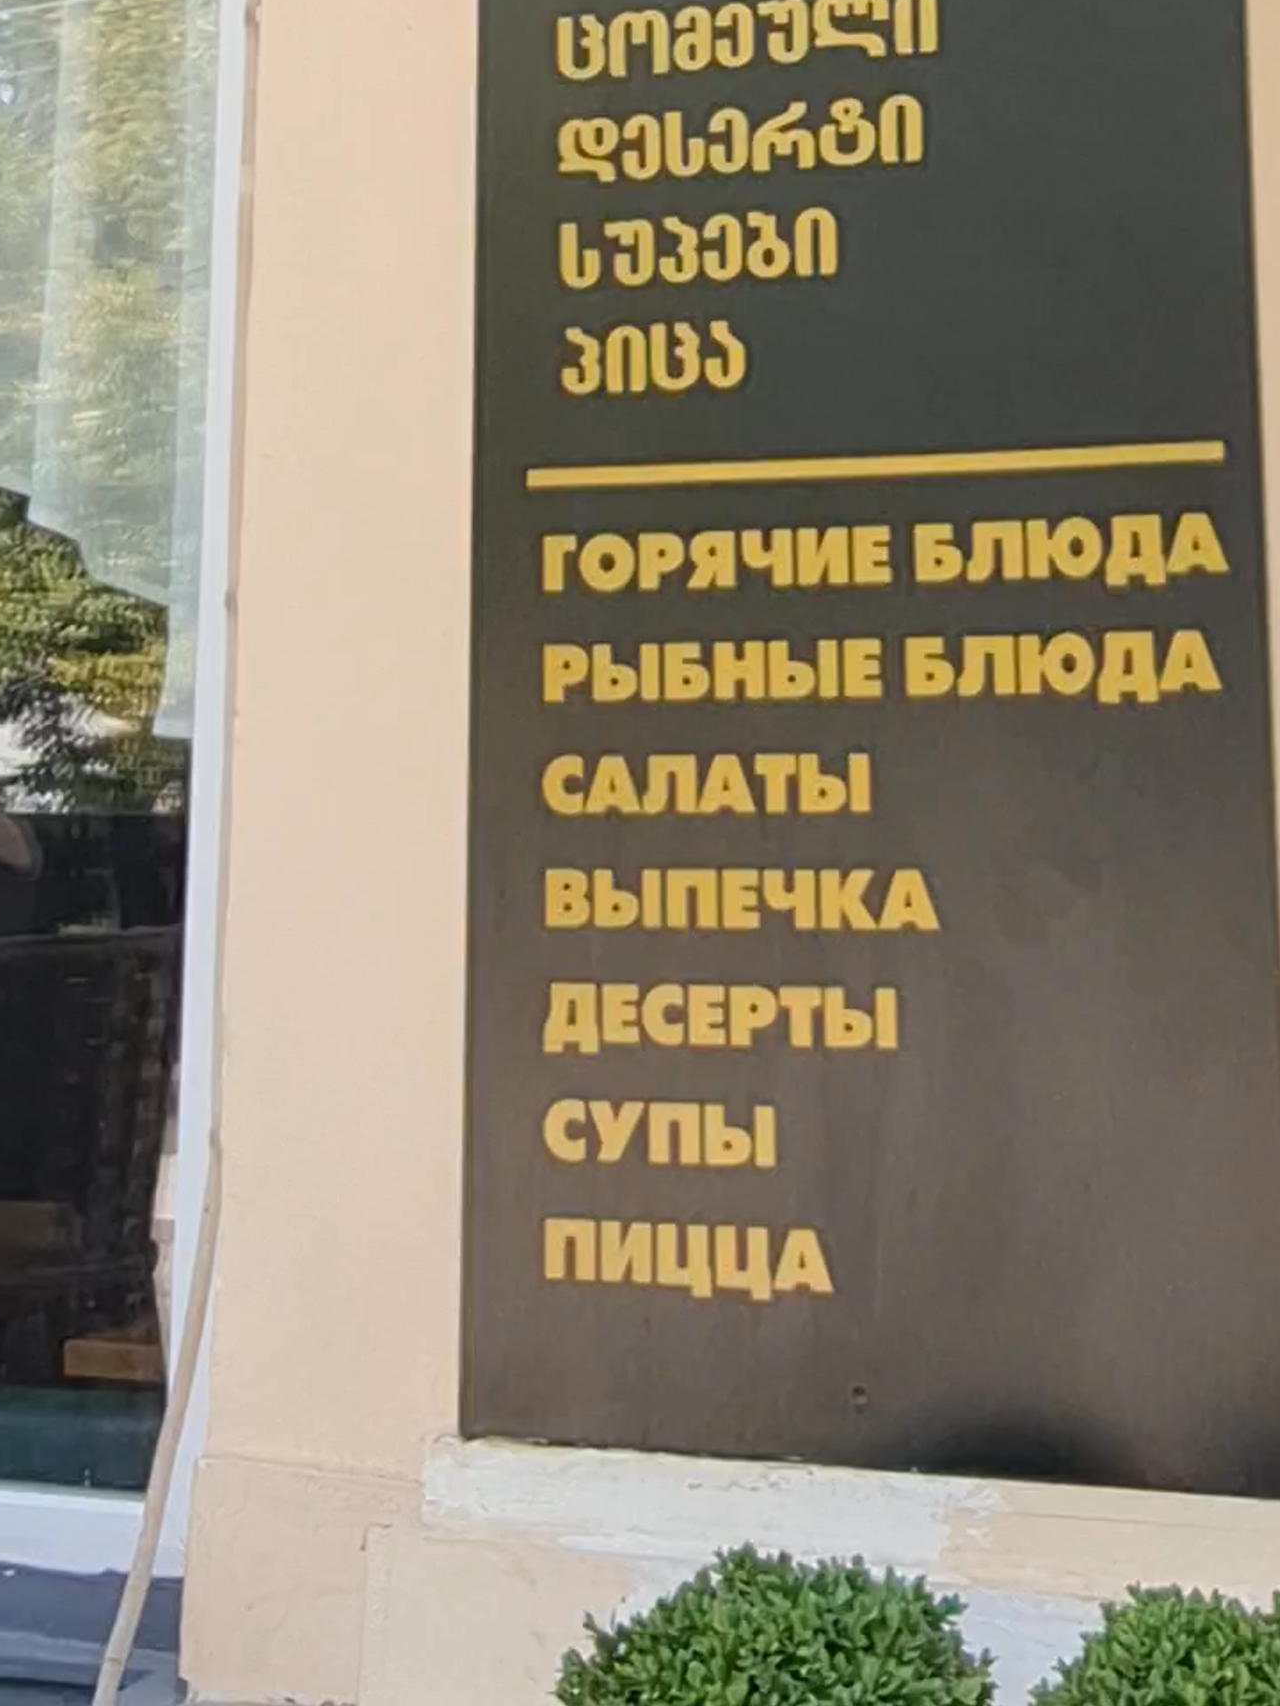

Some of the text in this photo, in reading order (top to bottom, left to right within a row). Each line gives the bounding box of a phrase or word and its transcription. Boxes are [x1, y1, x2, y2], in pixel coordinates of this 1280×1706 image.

[556, 94, 925, 183] დესერტი
[557, 206, 839, 290] სუპები
[559, 319, 747, 397] პიცა
[541, 512, 1229, 592] ГОРЯЧИЕ БЛЮДА
[541, 631, 1223, 704] РЫБНЫЕ БЛЮДА
[541, 753, 872, 815] САЛАТЫ
[541, 868, 939, 931] ВЫПЕЧКА
[541, 980, 900, 1054] ДЕСЕРТЫ
[541, 1098, 778, 1169] СУПЫ
[541, 1216, 835, 1302] ПИЦЦА
